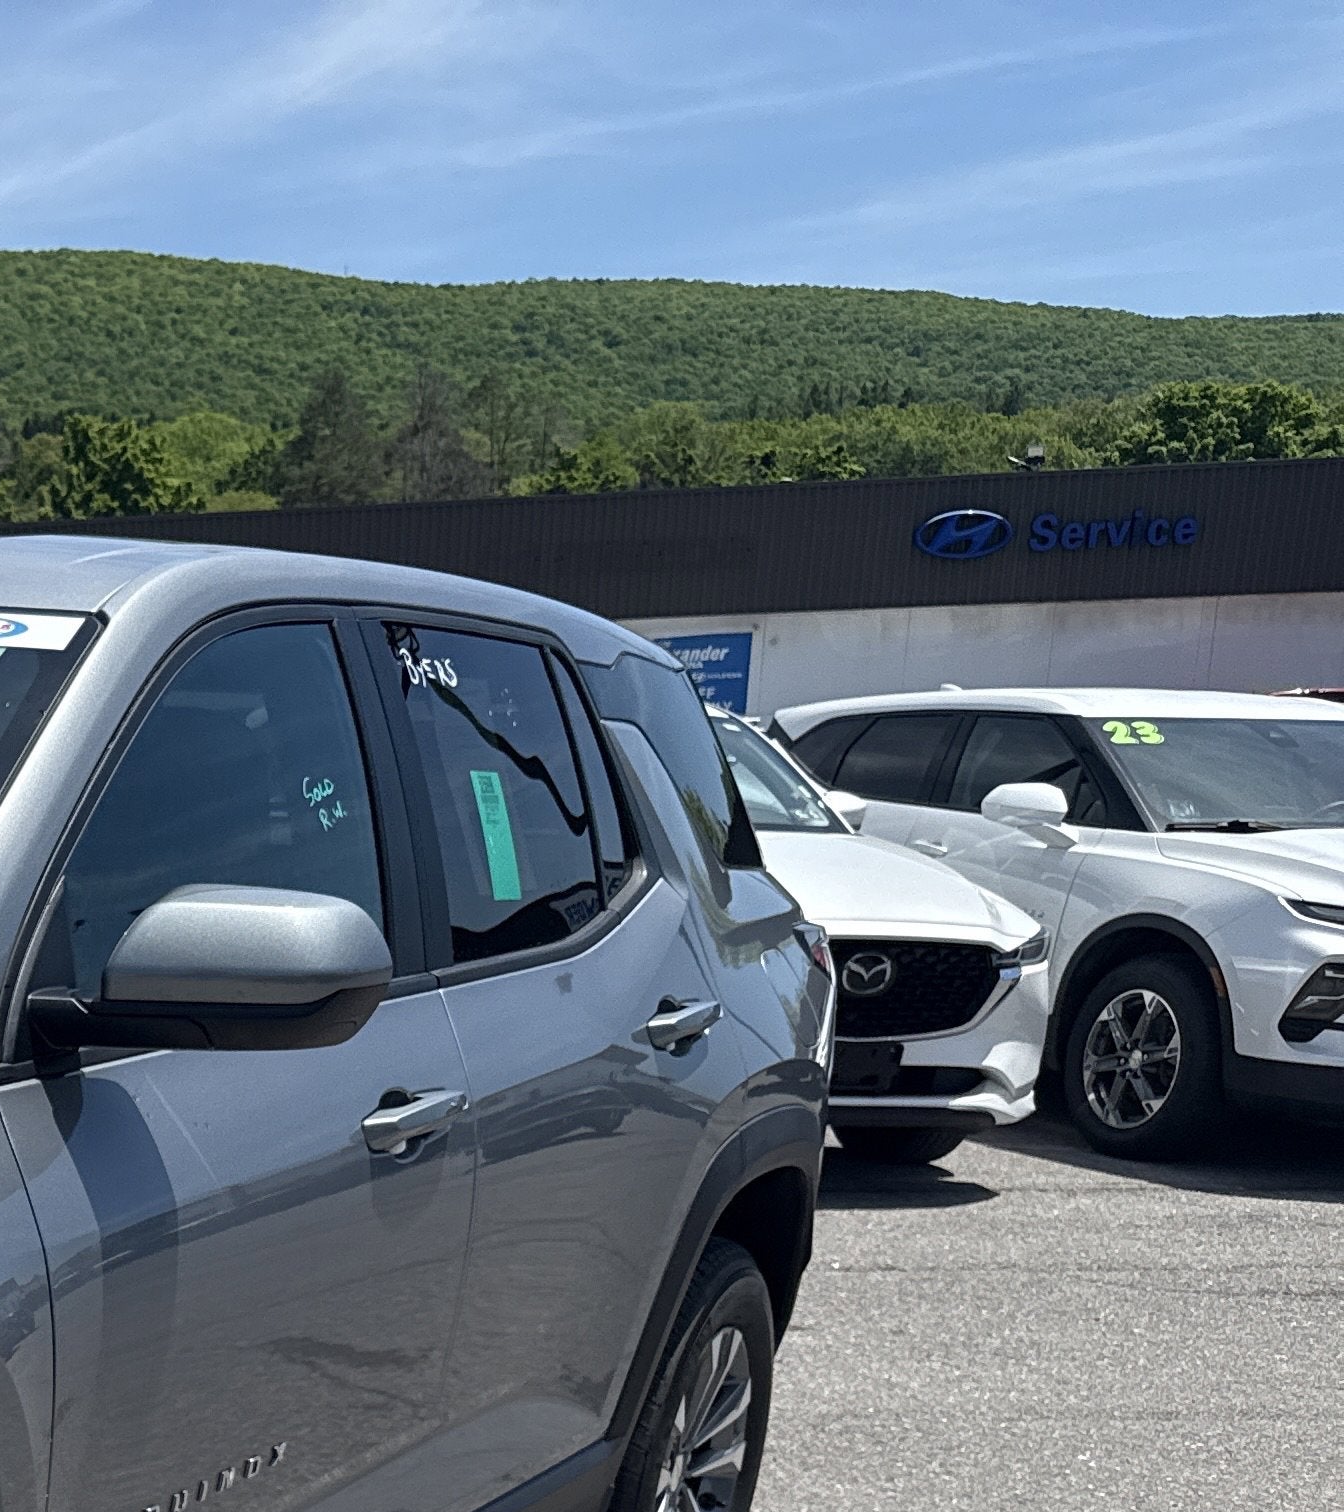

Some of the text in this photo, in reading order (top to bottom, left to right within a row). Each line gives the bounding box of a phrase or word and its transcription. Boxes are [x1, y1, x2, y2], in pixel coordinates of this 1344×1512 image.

[1028, 508, 1199, 551] Service
[399, 648, 458, 688] BYERS
[1102, 721, 1165, 744] 23
